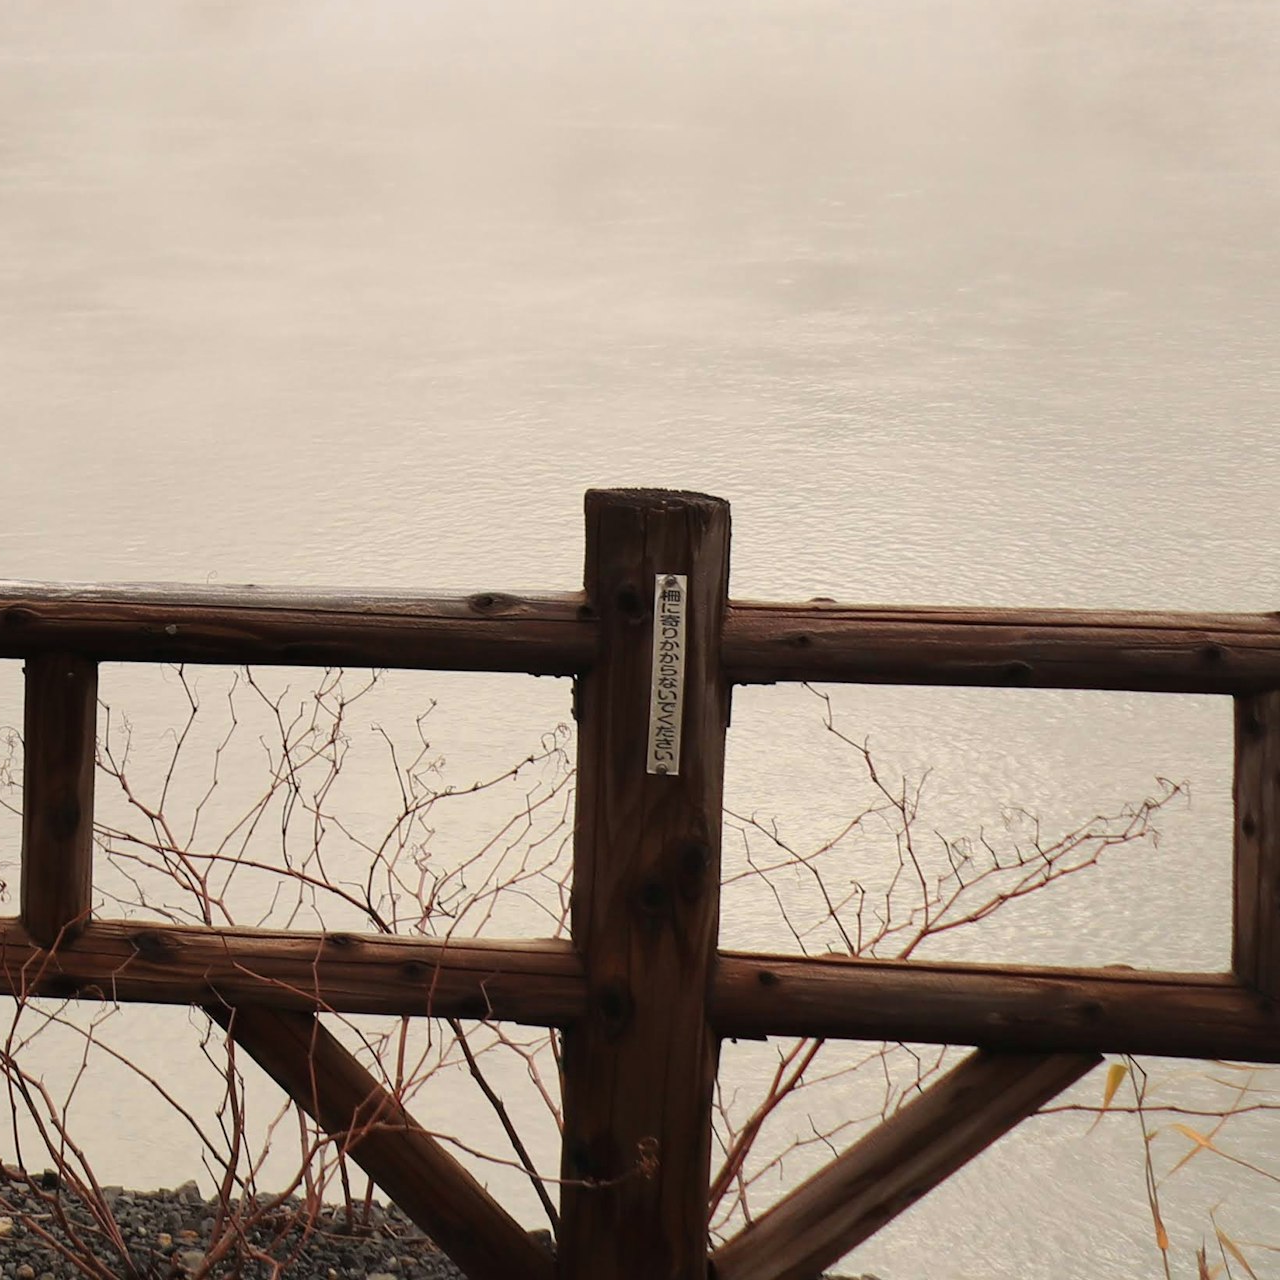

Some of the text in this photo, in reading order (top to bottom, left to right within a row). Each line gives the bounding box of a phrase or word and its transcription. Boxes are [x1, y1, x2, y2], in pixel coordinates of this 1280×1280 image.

[653, 589, 681, 761] 柵に寄りかからないでください
